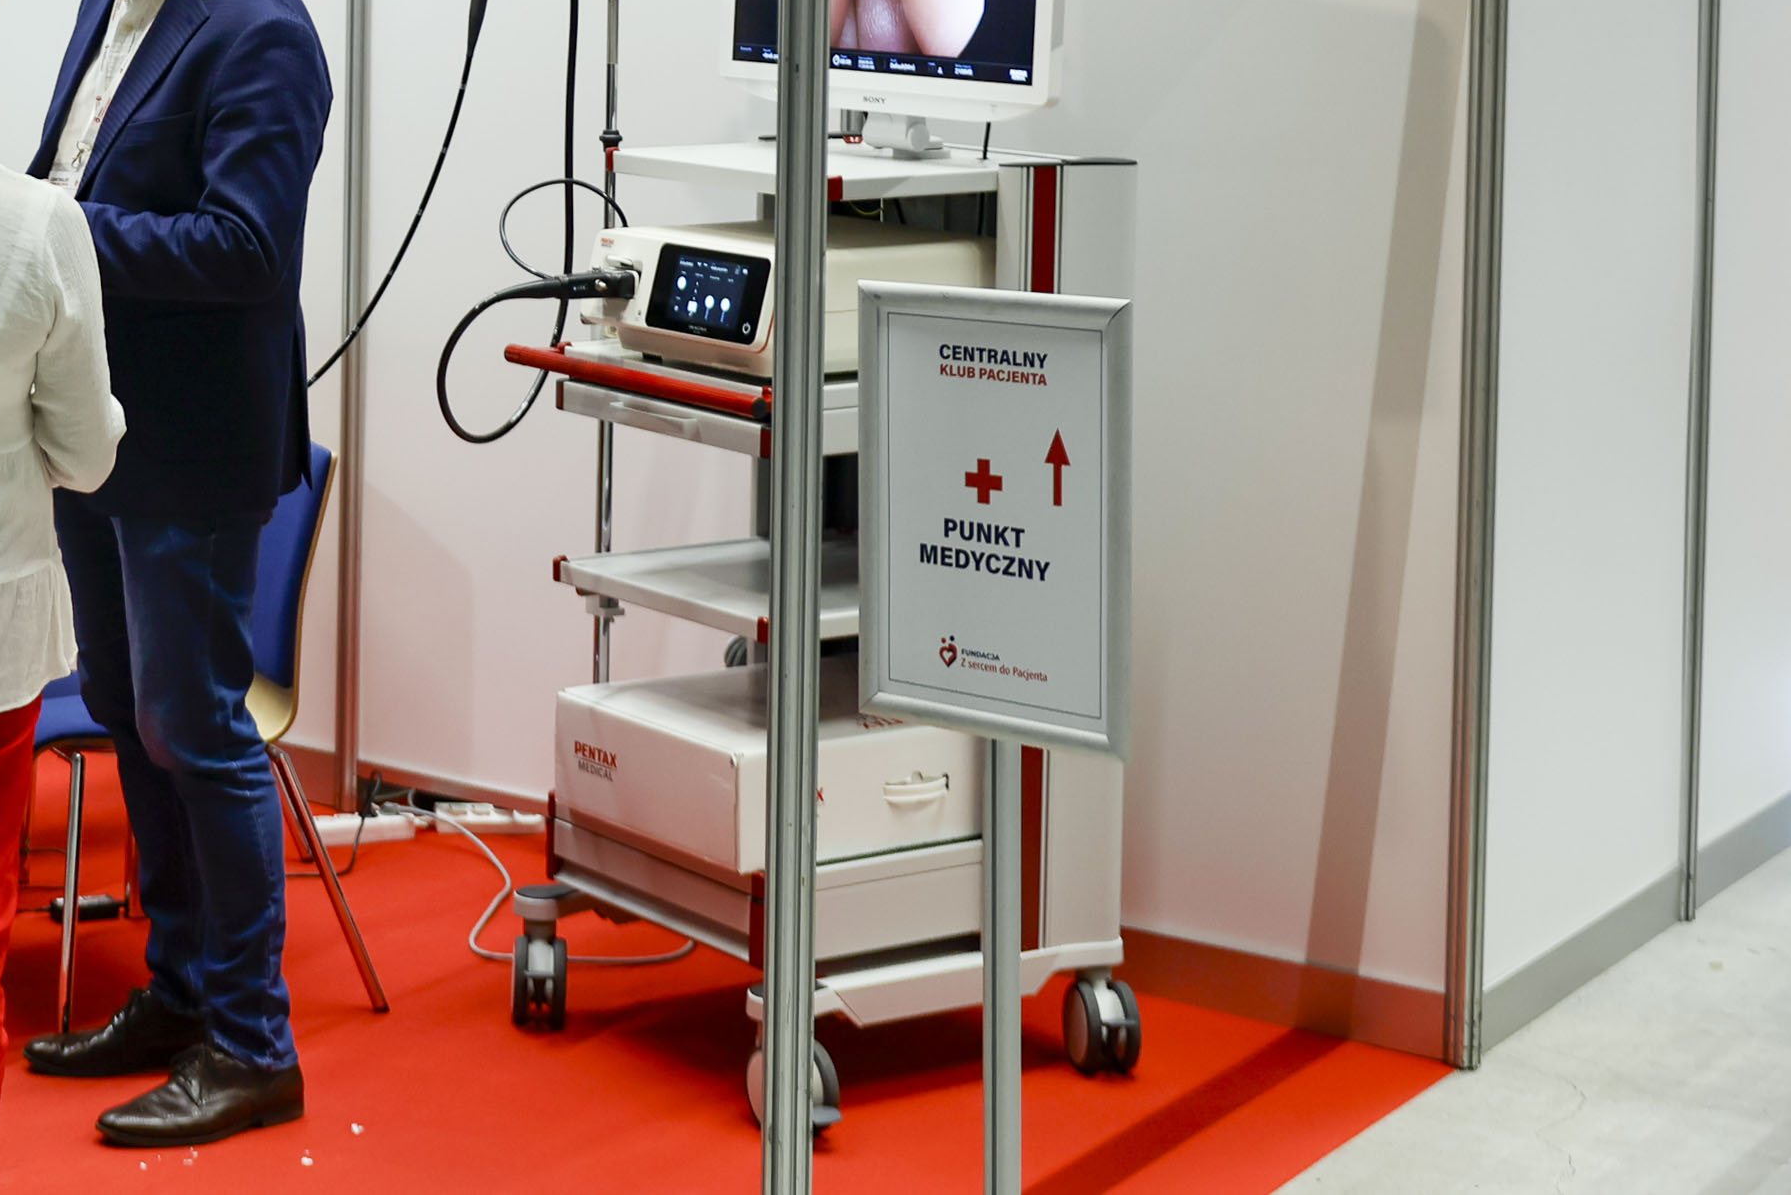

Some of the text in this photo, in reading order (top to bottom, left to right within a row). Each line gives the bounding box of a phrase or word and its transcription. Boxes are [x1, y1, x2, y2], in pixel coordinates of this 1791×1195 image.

[862, 94, 887, 105] SONY
[939, 344, 1048, 369] CENTRALNY
[939, 363, 1048, 386] KLUB PACJENTA
[943, 517, 1026, 549] PUNKT
[919, 542, 1051, 582] MEDYCZNY
[961, 648, 1000, 661] FUNDACJA
[960, 657, 1048, 682] Z sercem do Pacjenta
[574, 740, 617, 768] PENTAX
[578, 759, 613, 782] MEDICAL
